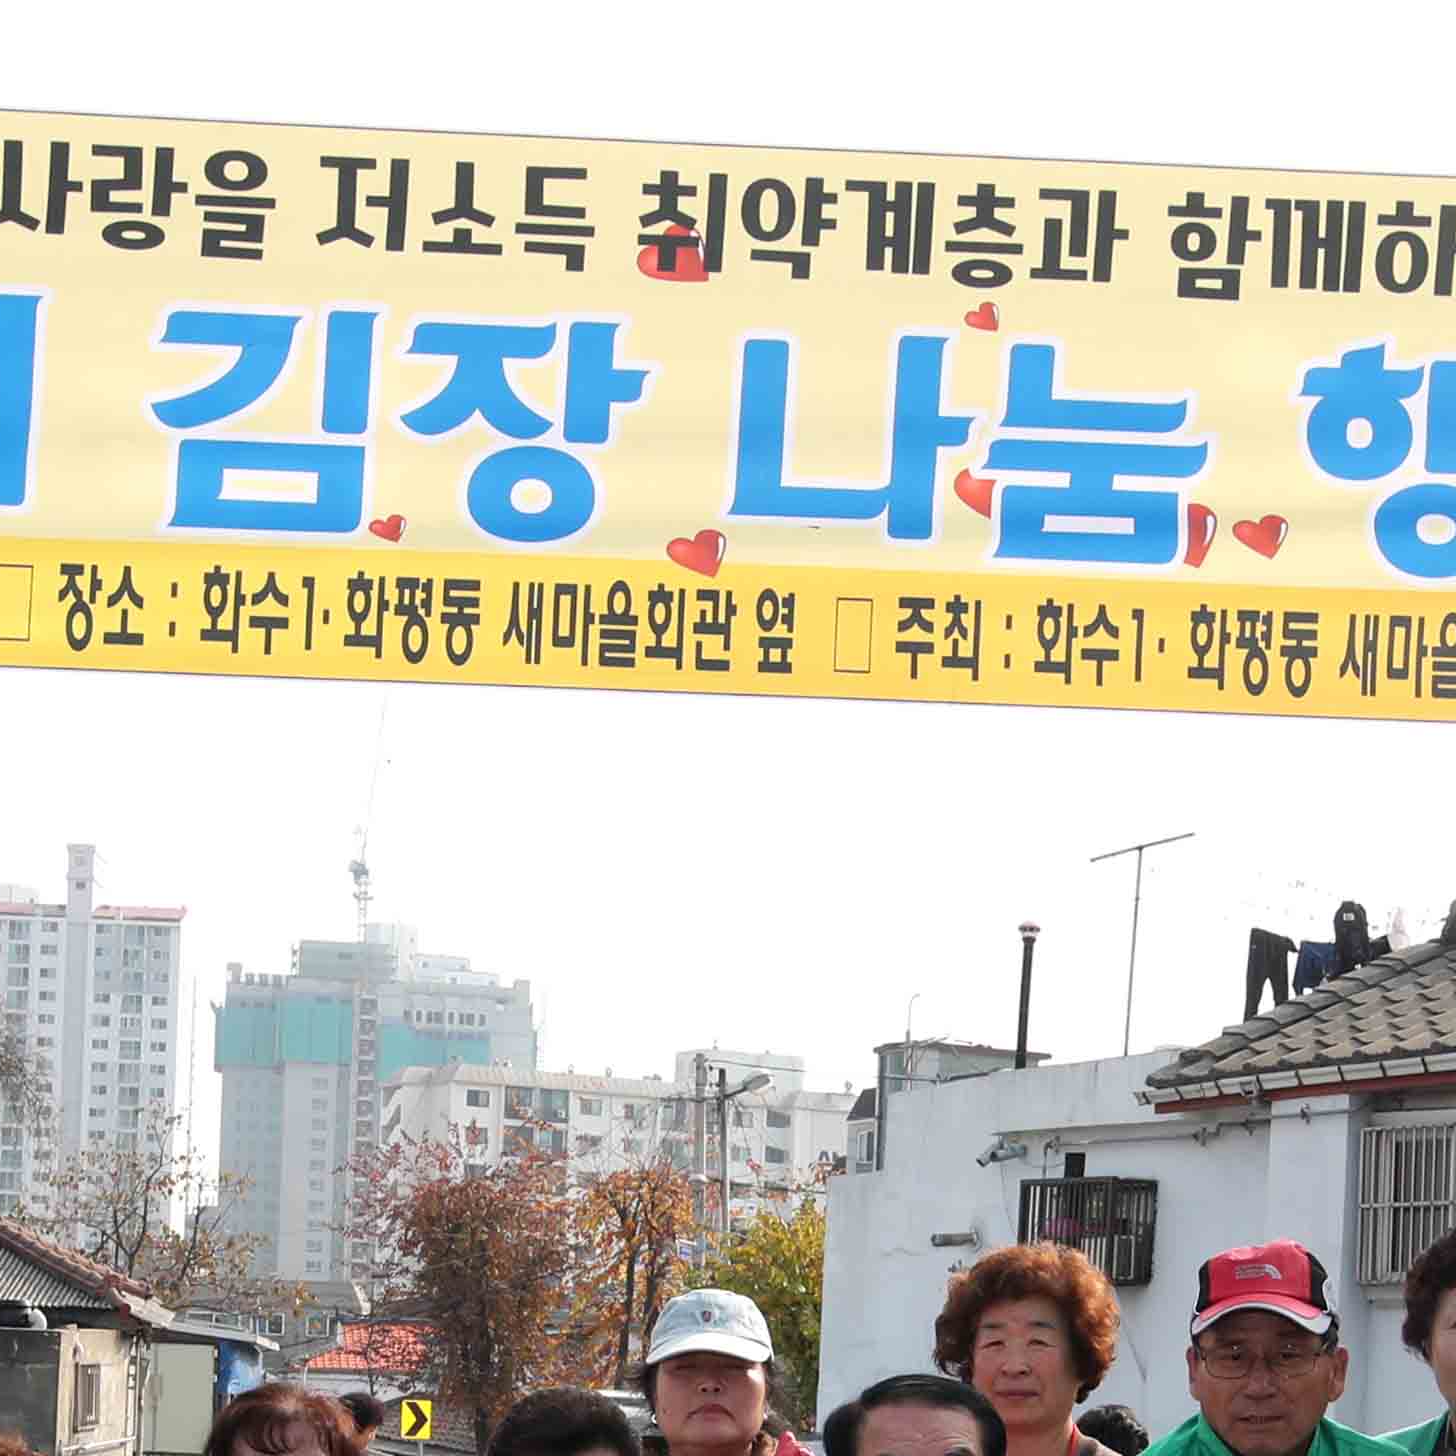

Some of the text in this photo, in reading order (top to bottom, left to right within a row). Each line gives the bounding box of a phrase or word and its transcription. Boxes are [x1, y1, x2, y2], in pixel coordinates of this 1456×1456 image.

[318, 156, 597, 273] 저소득
[638, 170, 1131, 289] 취약계층과
[152, 309, 647, 543] 김장
[730, 334, 1209, 565] 나눔
[503, 579, 737, 673] 새마을회관
[755, 588, 796, 674] 옆
